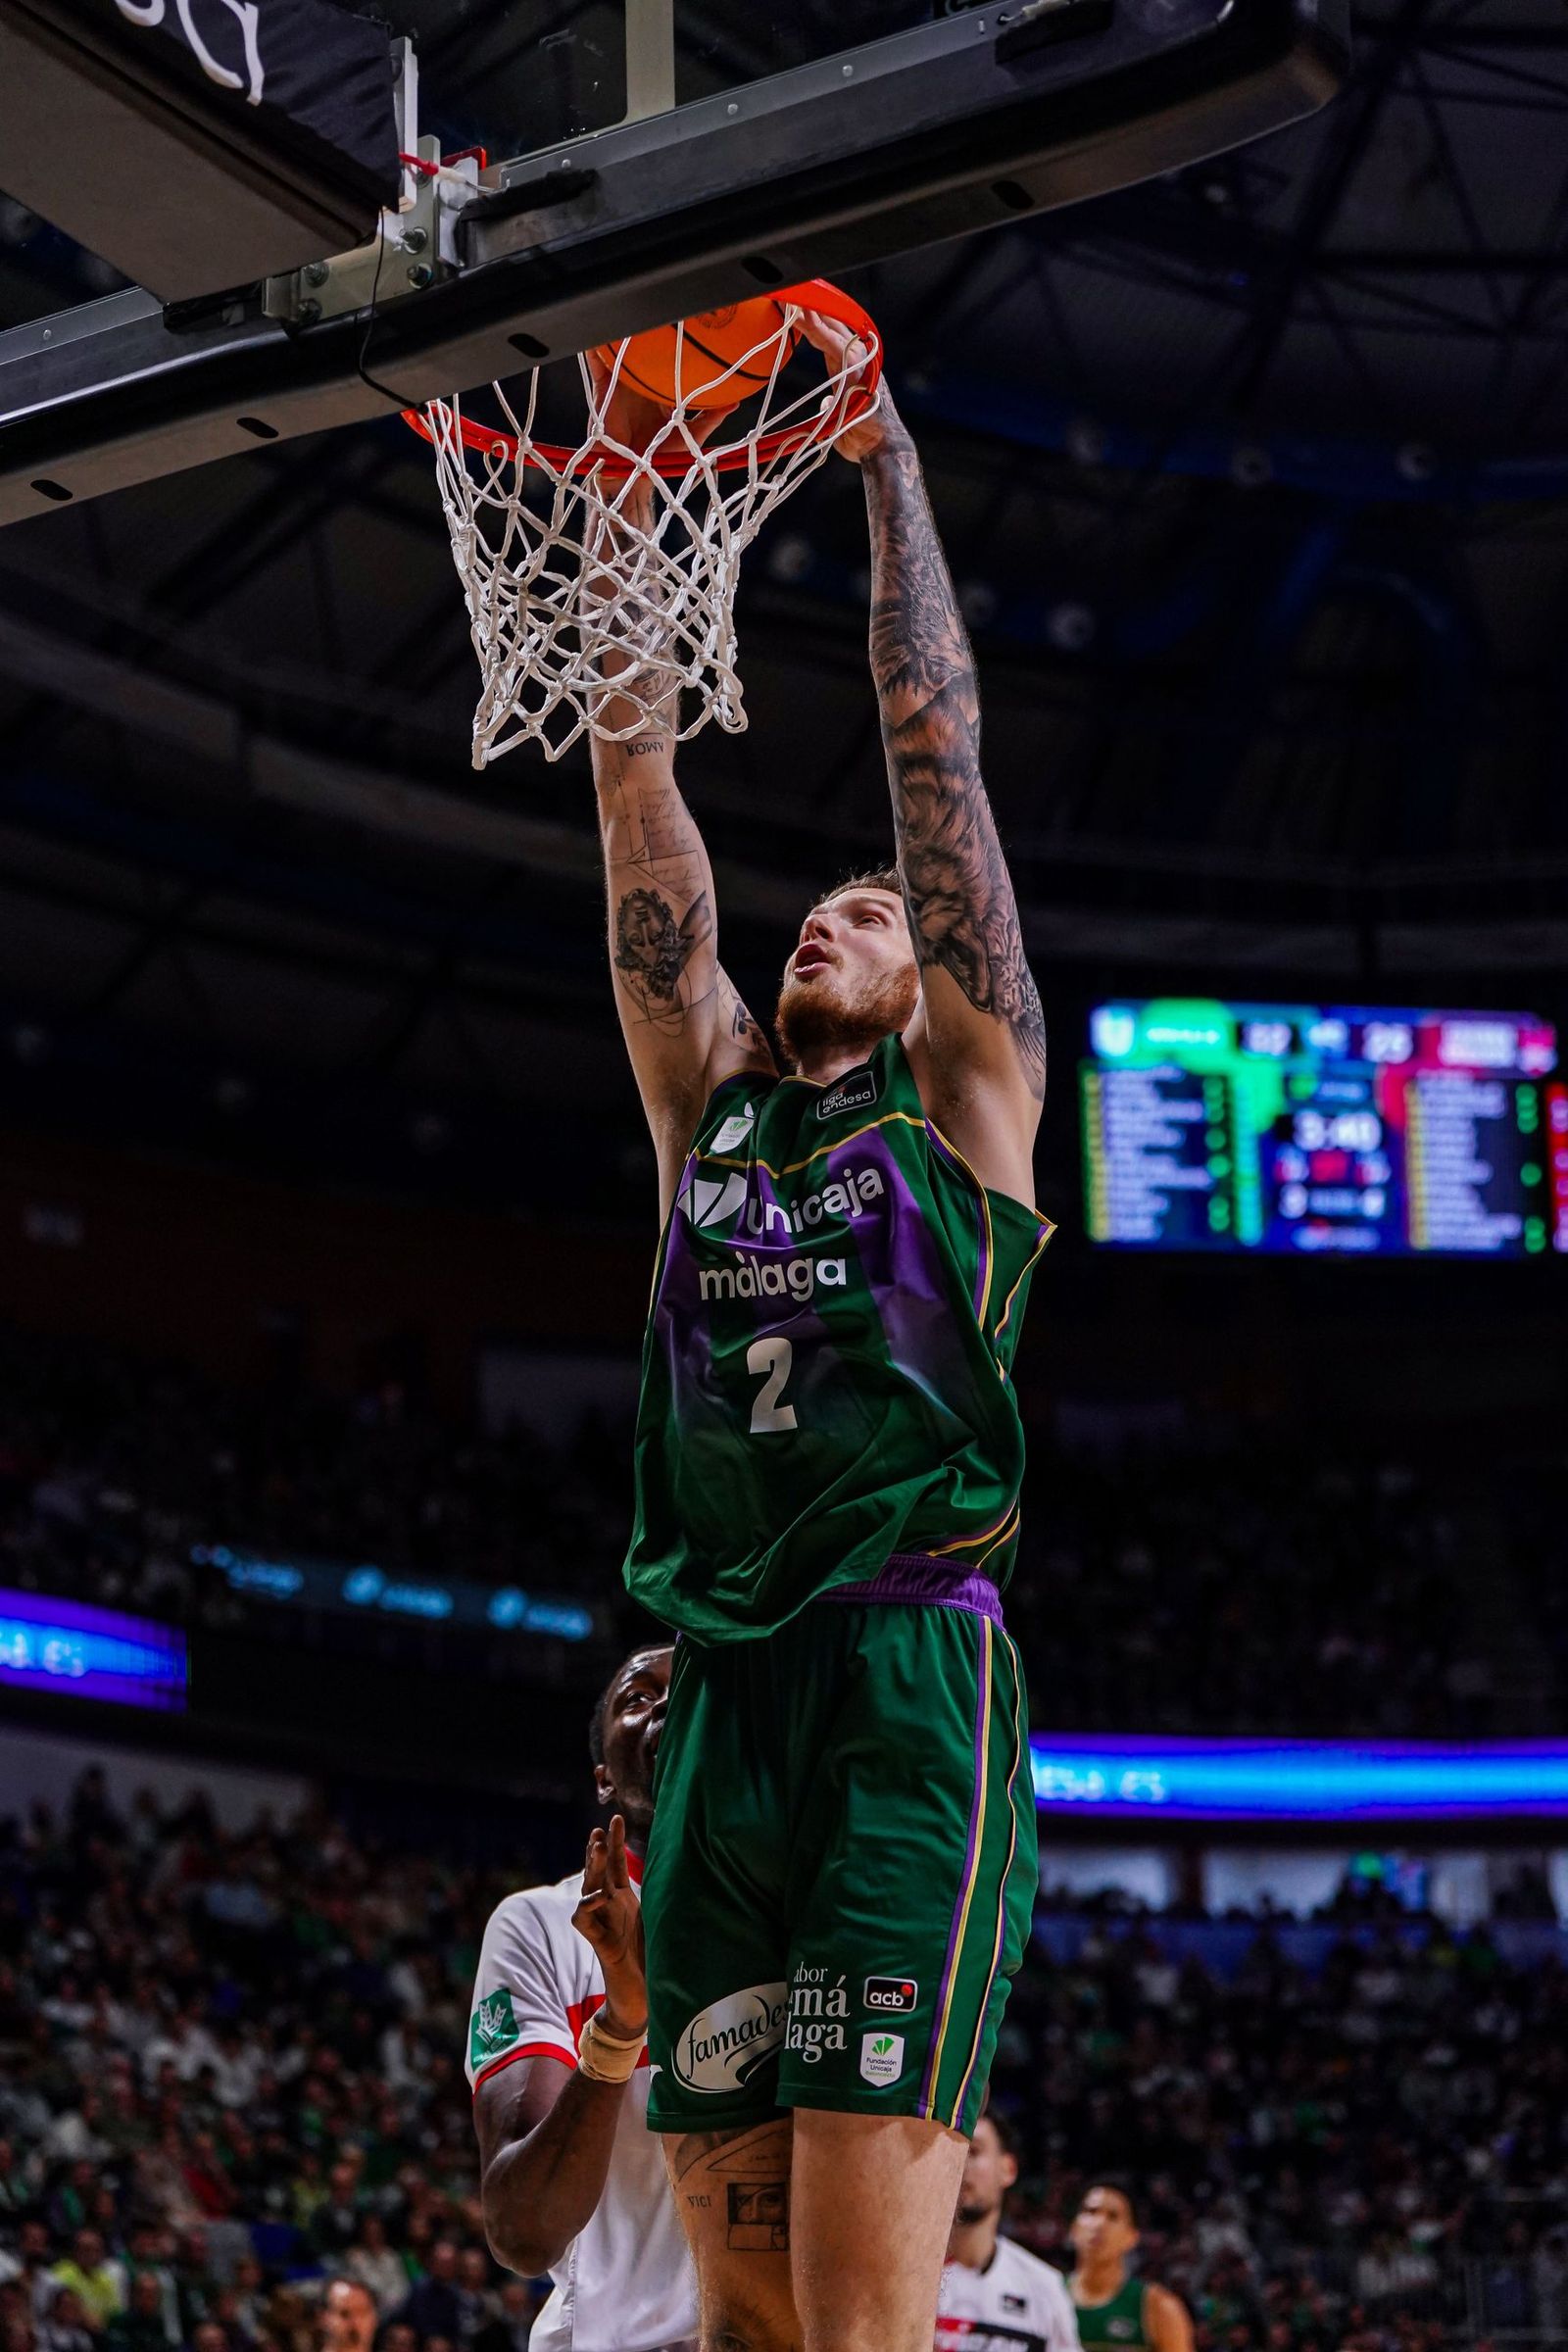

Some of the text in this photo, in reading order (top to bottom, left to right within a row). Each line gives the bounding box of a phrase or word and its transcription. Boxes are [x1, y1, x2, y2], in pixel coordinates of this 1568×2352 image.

[823, 1091, 871, 1113] endesa
[747, 1337, 798, 1433] 2
[794, 1961, 828, 1983] abor
[869, 1991, 904, 2007] acb
[687, 1994, 786, 2080] famade
